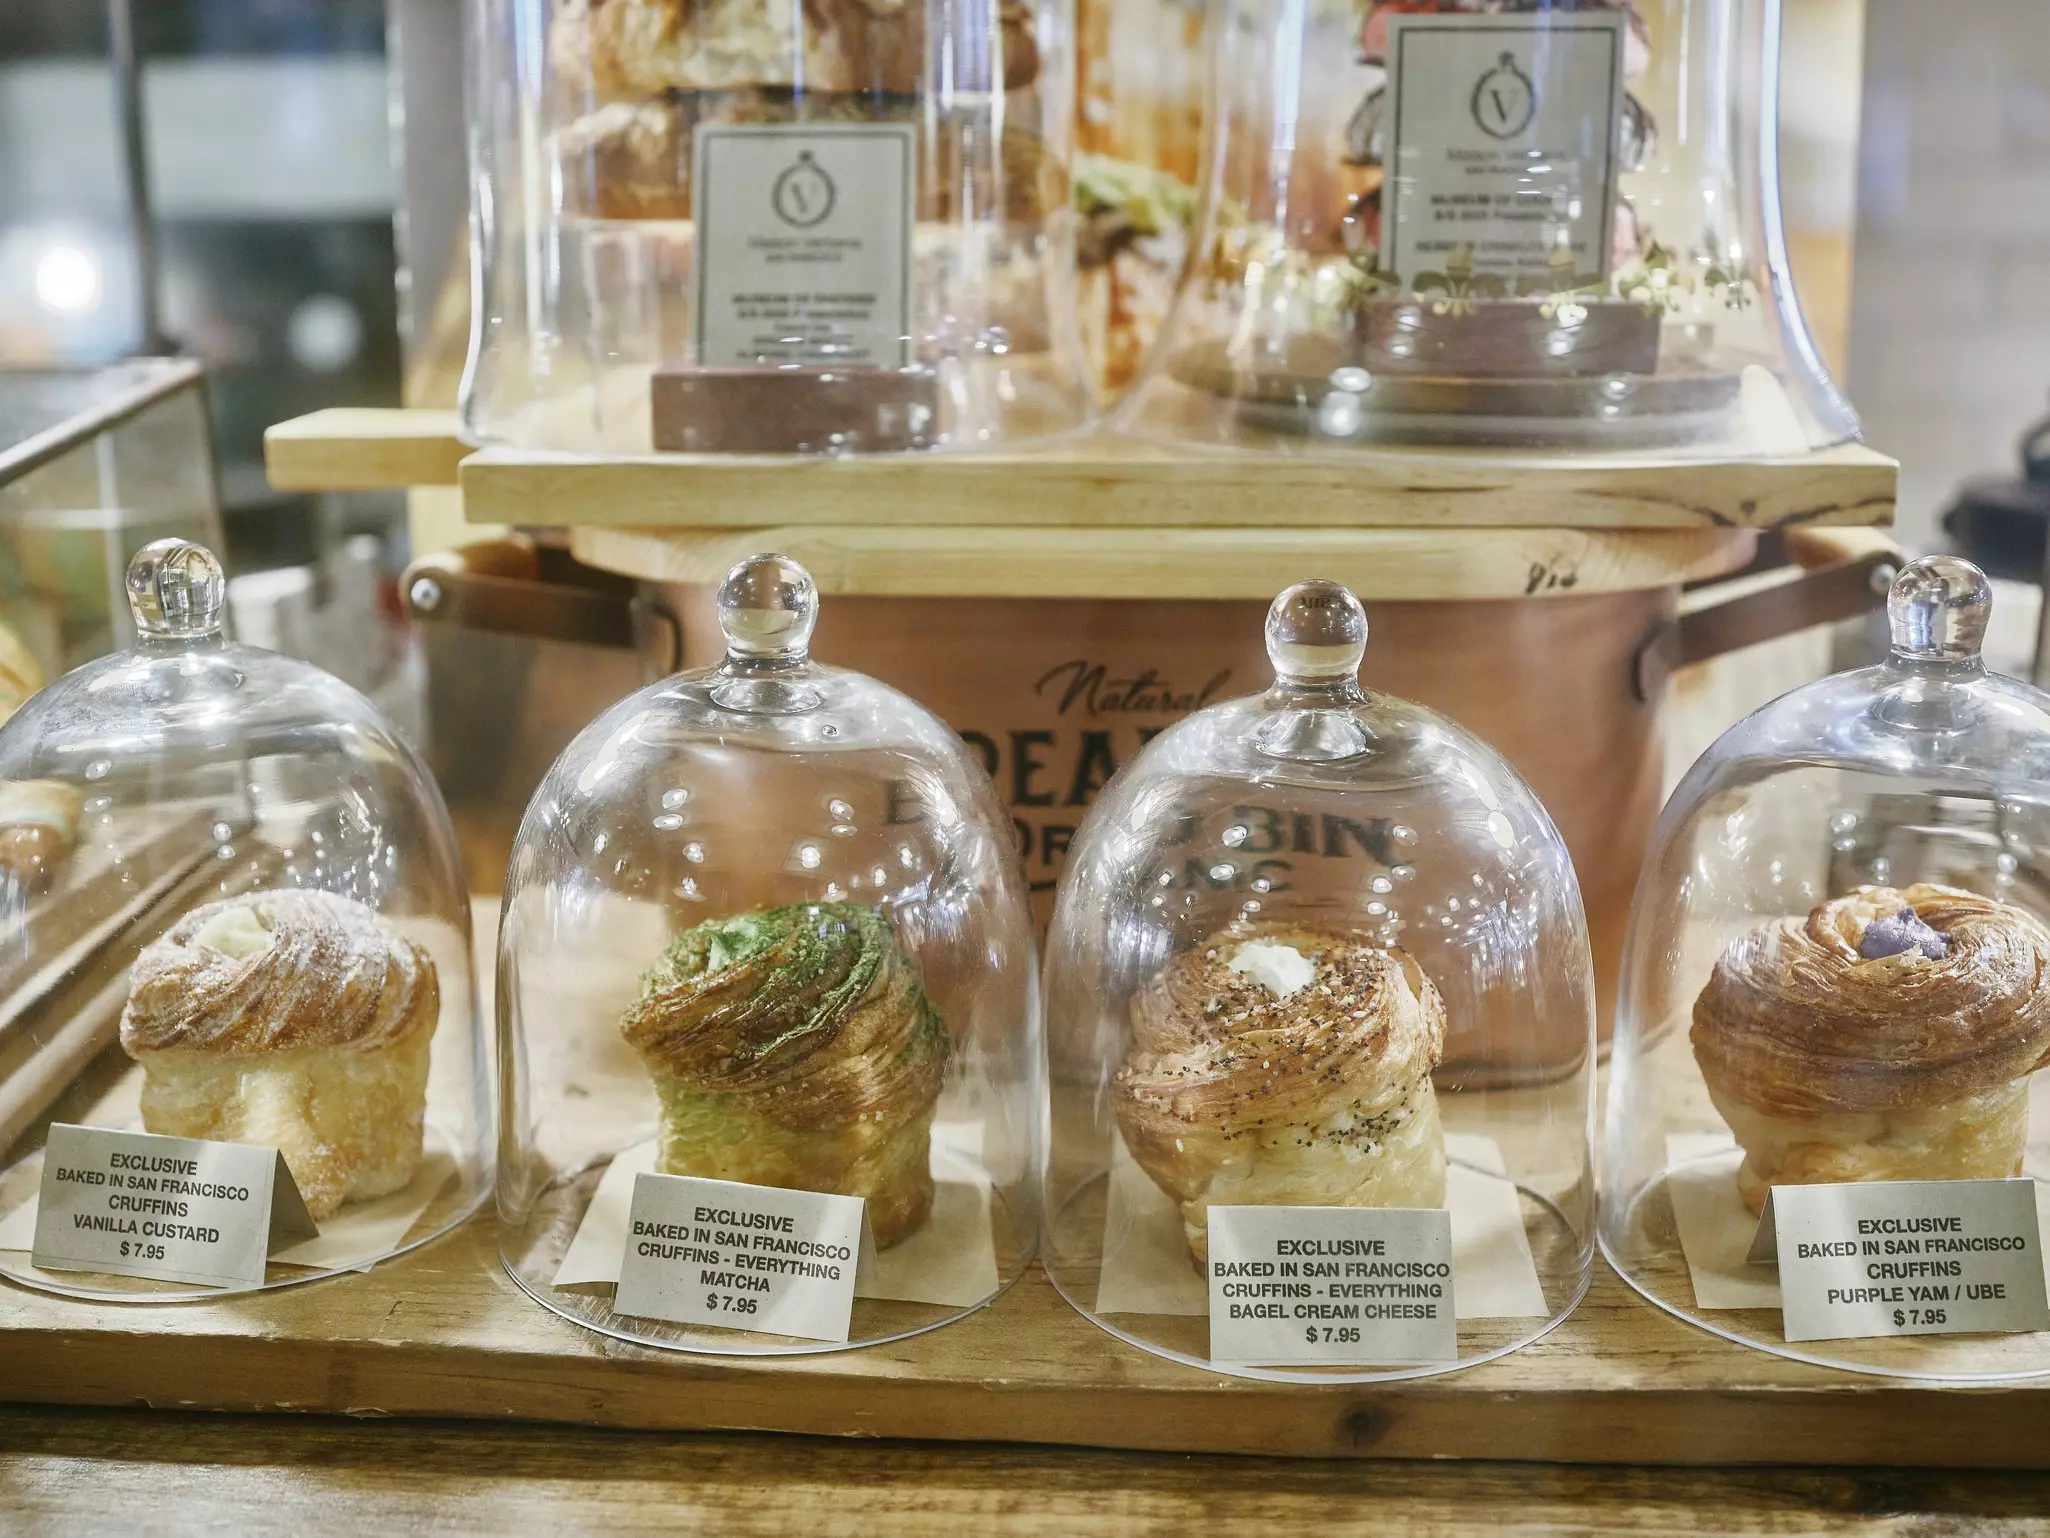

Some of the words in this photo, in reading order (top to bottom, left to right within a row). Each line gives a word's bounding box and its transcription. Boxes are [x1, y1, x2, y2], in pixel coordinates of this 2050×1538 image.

[1034, 658, 1234, 718] Natural
[110, 1153, 198, 1175] EXCLUSIVE
[56, 1168, 105, 1186] BAKED
[109, 1174, 124, 1188] IN
[127, 1176, 156, 1191] SAN
[161, 1180, 249, 1201] FRANCISCO
[109, 1195, 188, 1217] CRUFFINS
[74, 1214, 137, 1235] VANILLA
[142, 1222, 220, 1243] CUSTARD
[694, 1207, 794, 1233] EXCLUSIVE
[1858, 1217, 1962, 1234] EXCLUSIVE
[120, 1240, 129, 1256] $
[134, 1243, 165, 1260] 7.95
[633, 1221, 689, 1240] BAKED
[694, 1229, 710, 1243] IN
[714, 1231, 748, 1248] SAN
[753, 1235, 850, 1260] FRANCISCO
[1277, 1240, 1385, 1256] EXCLUSIVE
[1798, 1242, 1857, 1258] BAKED
[1863, 1241, 1879, 1256] IN
[1884, 1239, 1920, 1255] SAN
[1925, 1236, 2026, 1253] FRANCISCO
[637, 1242, 719, 1264] CRUFFINS
[735, 1254, 840, 1280] EVERYTHING
[1214, 1262, 1274, 1277] BAKED
[1281, 1263, 1298, 1277] IN
[1303, 1263, 1339, 1277] SAN
[1346, 1263, 1450, 1278] FRANCISCO
[1867, 1261, 1962, 1279] CRUFFINS
[701, 1270, 770, 1292] MATCHA
[1222, 1284, 1311, 1298] CRUFFINS
[1329, 1284, 1442, 1298] EVERYTHING
[706, 1293, 717, 1311] $
[722, 1296, 757, 1314] 7.95
[1828, 1287, 1904, 1304] PURPLE
[1908, 1286, 1949, 1301] YAM
[1954, 1285, 1961, 1300] /
[1967, 1284, 2006, 1299] UBE
[1230, 1304, 1289, 1319] BAGEL
[1294, 1304, 1359, 1319] CREAM
[1365, 1304, 1436, 1319] CHEESE
[1893, 1309, 1905, 1327] $
[1909, 1309, 1946, 1325] 7.95
[1306, 1326, 1318, 1343] $
[1323, 1327, 1361, 1343] 7.95
